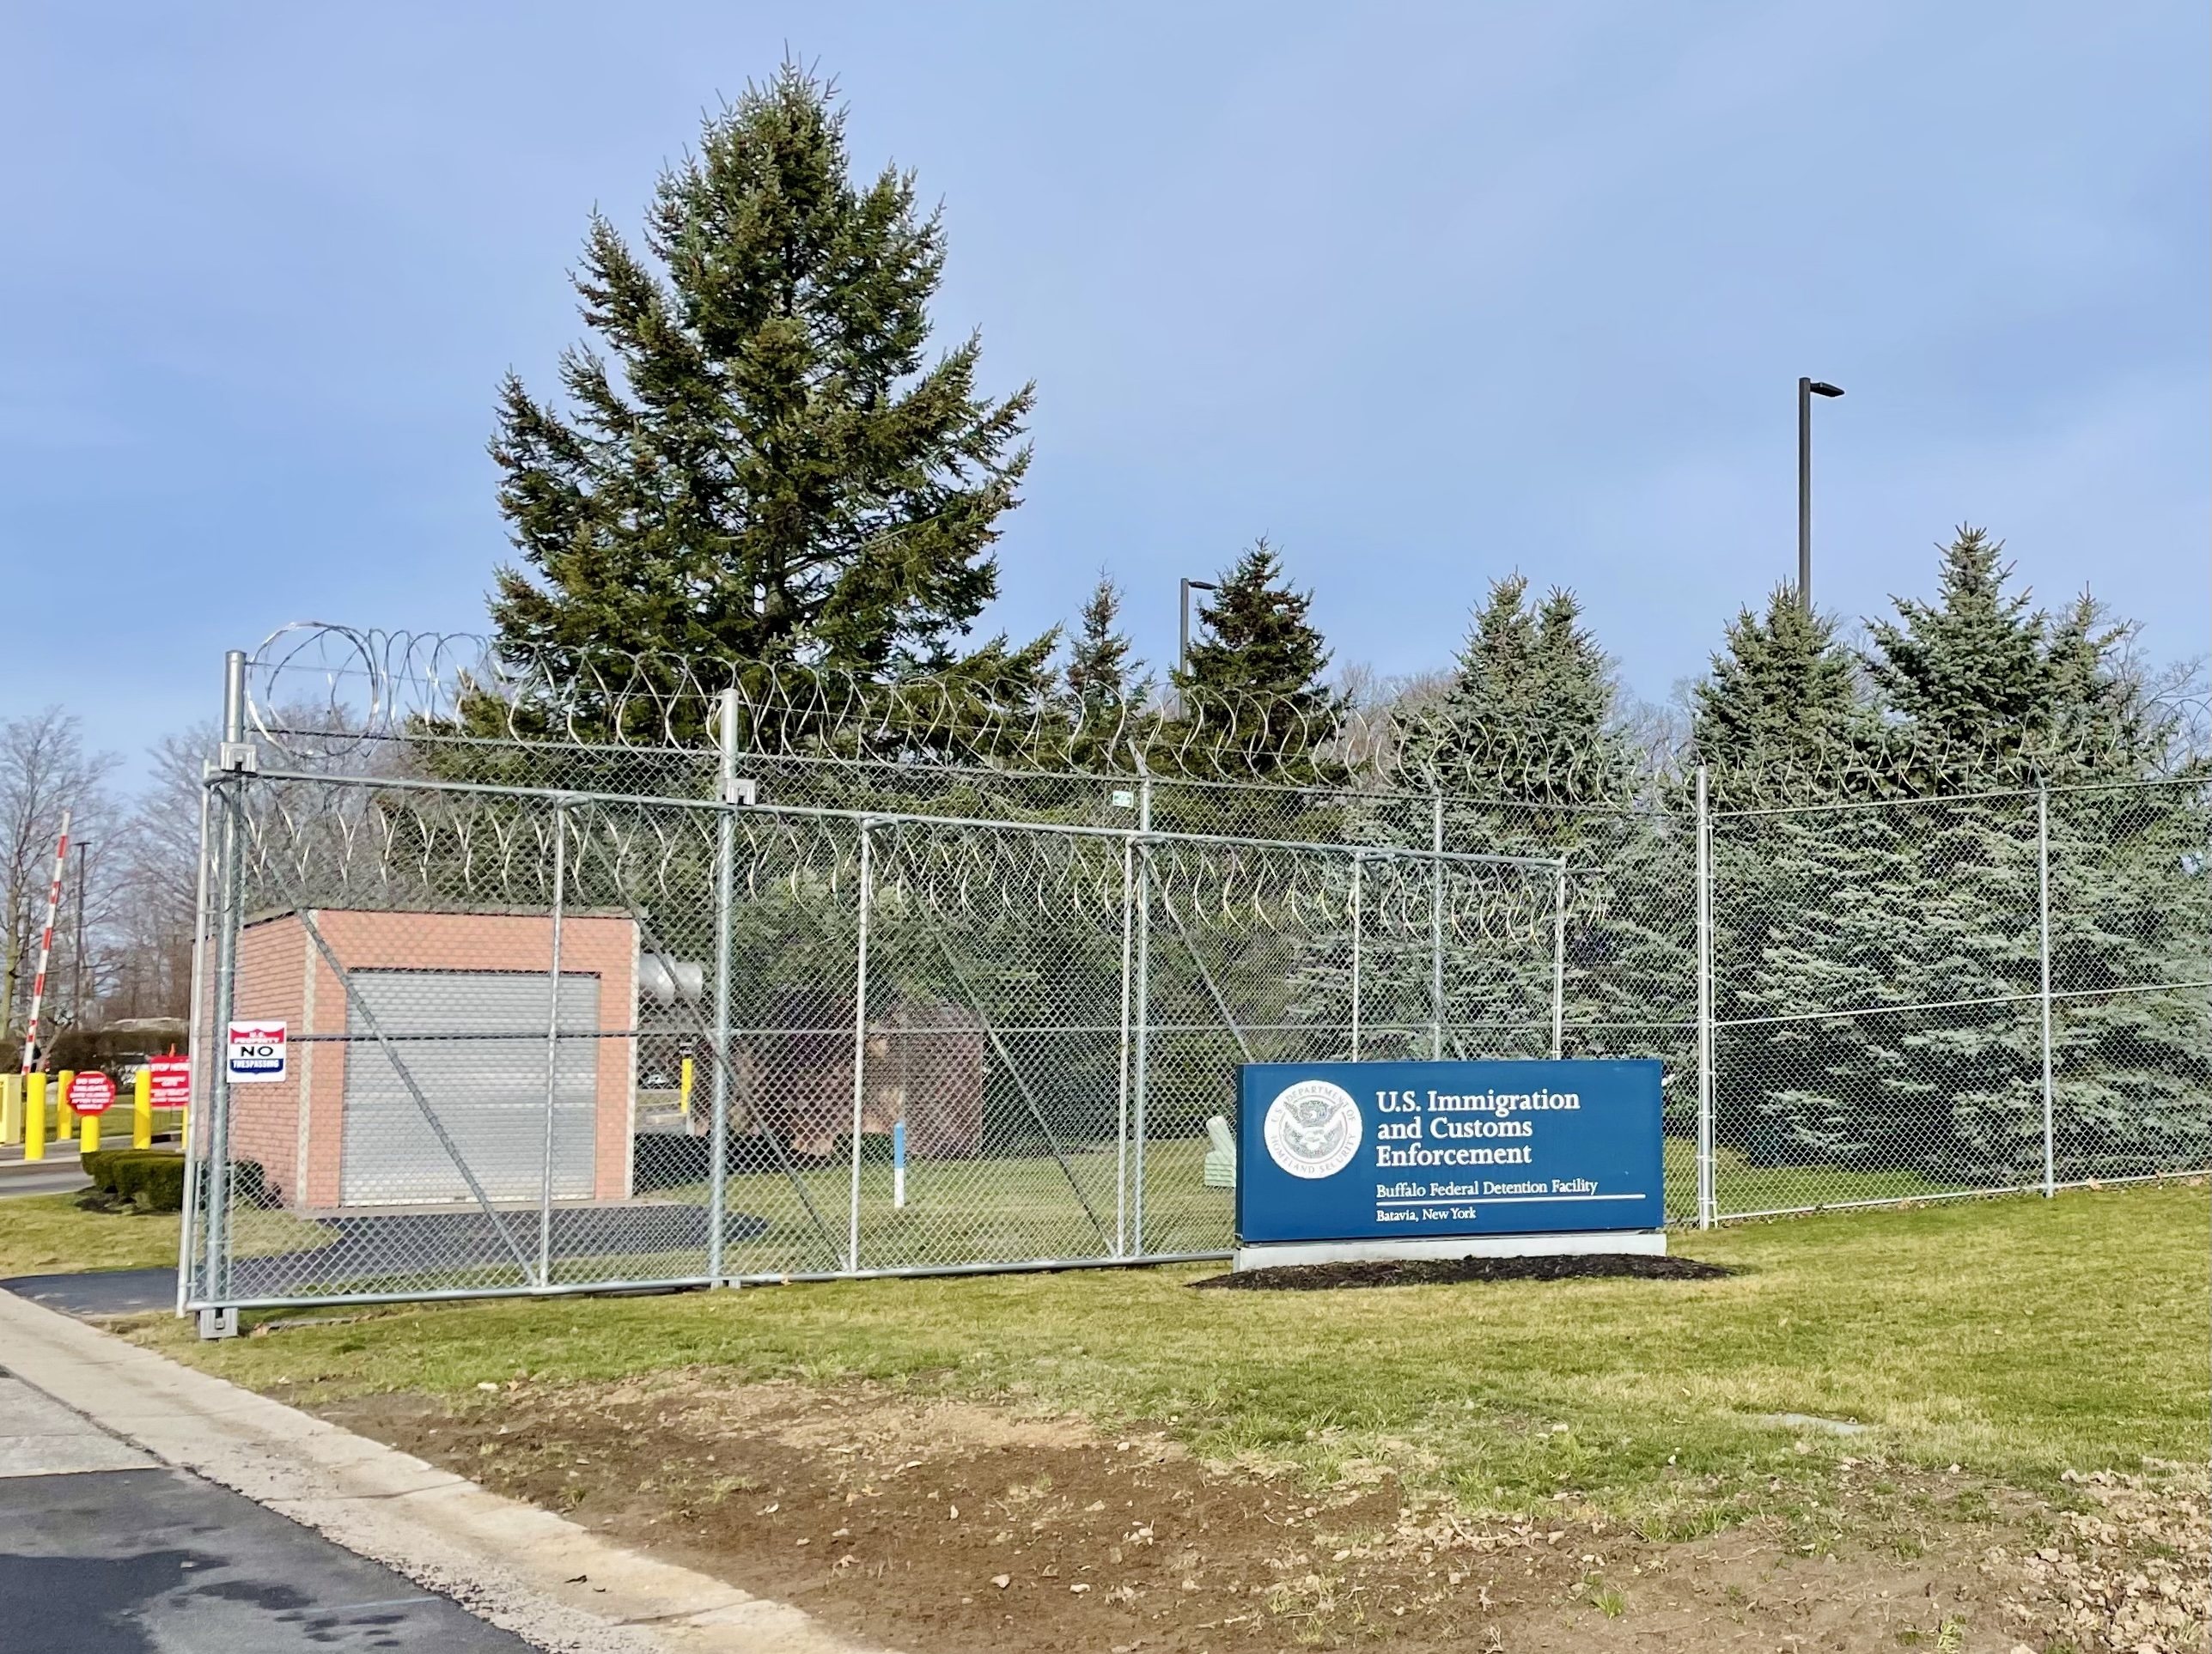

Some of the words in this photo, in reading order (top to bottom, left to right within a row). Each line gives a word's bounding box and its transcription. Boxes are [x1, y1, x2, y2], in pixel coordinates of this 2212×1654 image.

[241, 1046, 274, 1056] NO
[150, 1062, 170, 1072] STOP
[233, 1060, 280, 1068] TRESPASSING
[1285, 1085, 1350, 1109] DEPARTMENT
[1346, 1108, 1356, 1122] OF
[1376, 1091, 1422, 1113] U.S.
[1427, 1088, 1581, 1117] Immigration
[1377, 1116, 1423, 1140] and
[1429, 1117, 1533, 1139] Customs
[1271, 1134, 1315, 1174] HOMELAND
[1319, 1134, 1356, 1174] SECURITY
[1375, 1143, 1533, 1167] Enforcement
[1376, 1183, 1426, 1198] Buffalo
[1429, 1181, 1479, 1196] Federal
[1483, 1180, 1547, 1195] Detention
[1551, 1177, 1599, 1195] Facility
[1376, 1209, 1419, 1222] Batavia,
[1422, 1208, 1448, 1220] New
[1449, 1207, 1477, 1219] York
